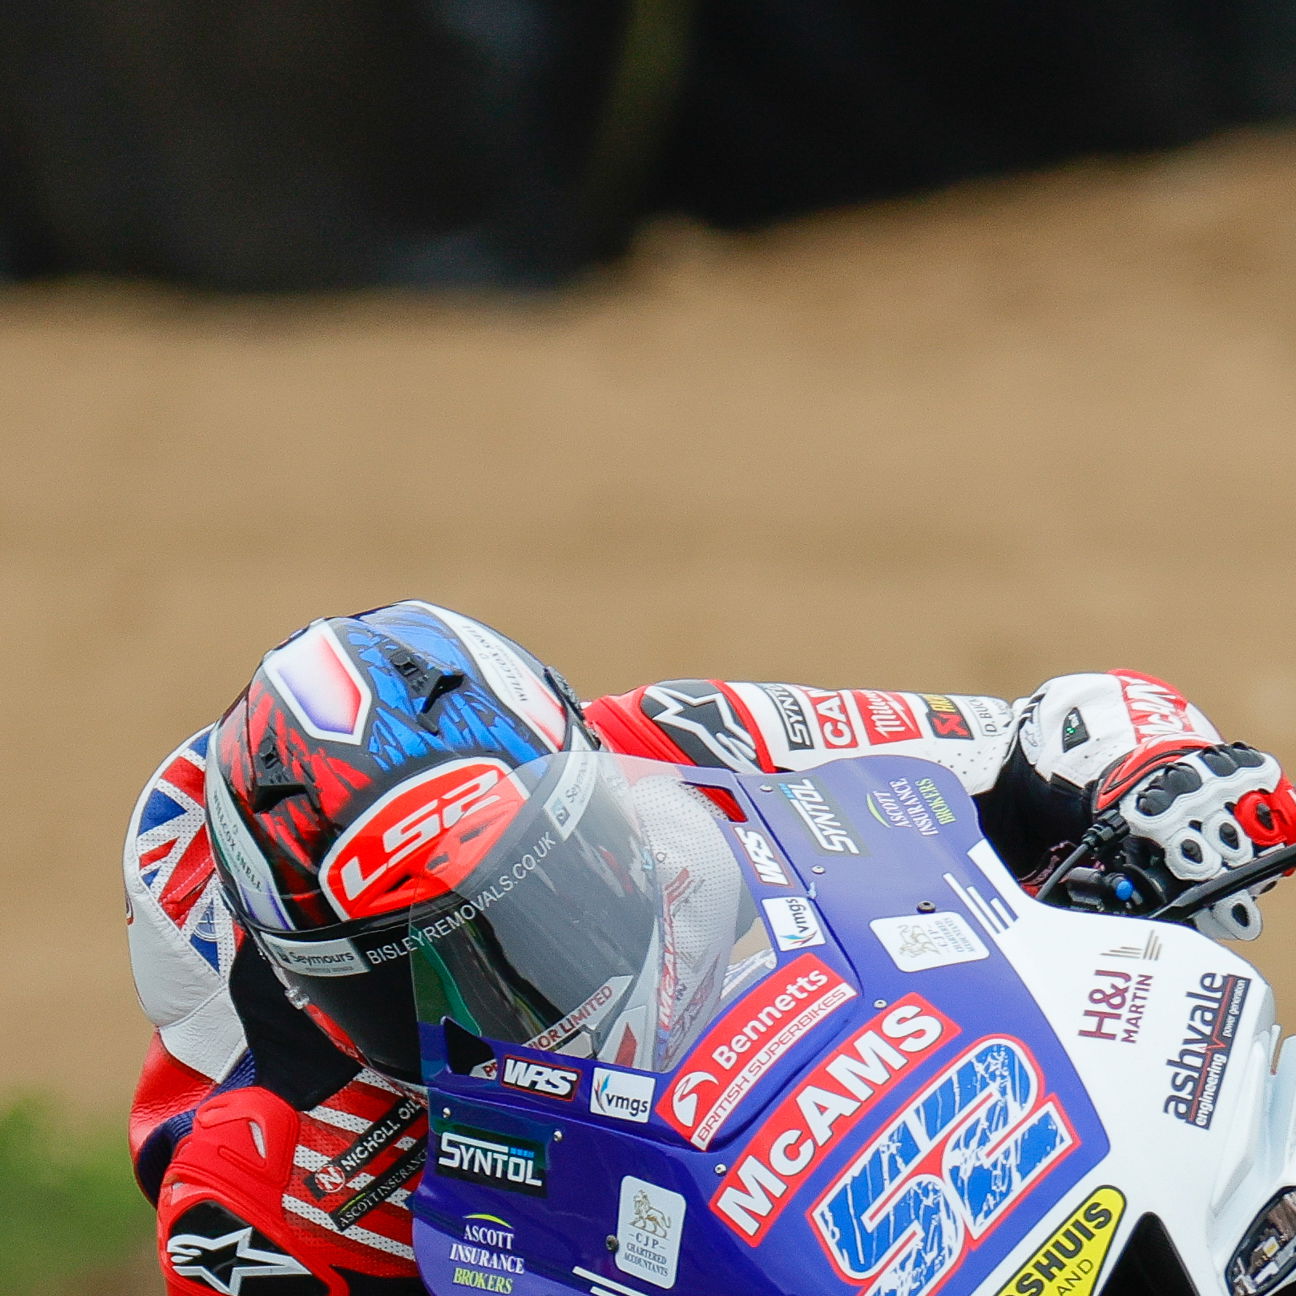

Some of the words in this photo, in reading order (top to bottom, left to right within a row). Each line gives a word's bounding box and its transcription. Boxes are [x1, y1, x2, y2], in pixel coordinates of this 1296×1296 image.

[788, 778, 859, 854] SYNTOL
[889, 778, 939, 836] INSURANCE
[914, 778, 957, 825] BROKERS
[340, 769, 501, 901] LS2
[734, 826, 790, 886] WRS
[366, 831, 556, 965] BISLEYREMOVALS.CO.UK
[290, 951, 354, 967] Seymours
[562, 985, 613, 1034] LIMITED
[711, 968, 829, 1071] Bennetts
[1077, 969, 1132, 1041] H&J
[1120, 973, 1154, 1044] MARTIN
[699, 1075, 750, 1142] BRITISH
[747, 988, 846, 1077] SUPERBIKES
[1162, 971, 1228, 1121] ashvale
[503, 1058, 579, 1096] WRS
[605, 1093, 649, 1117] vmgs
[1195, 1053, 1228, 1127] engineering
[341, 1117, 400, 1172] NICHOLL
[715, 1004, 944, 1238] McAMS
[340, 1193, 379, 1227] ASCOTT
[378, 1150, 428, 1201] INSURANC
[438, 1131, 543, 1187] SYNTOL
[450, 1244, 525, 1274] INSURANCE
[463, 1224, 515, 1250] ASCOTT
[626, 1242, 667, 1265] CHARTERED
[452, 1267, 513, 1295] BROKERS
